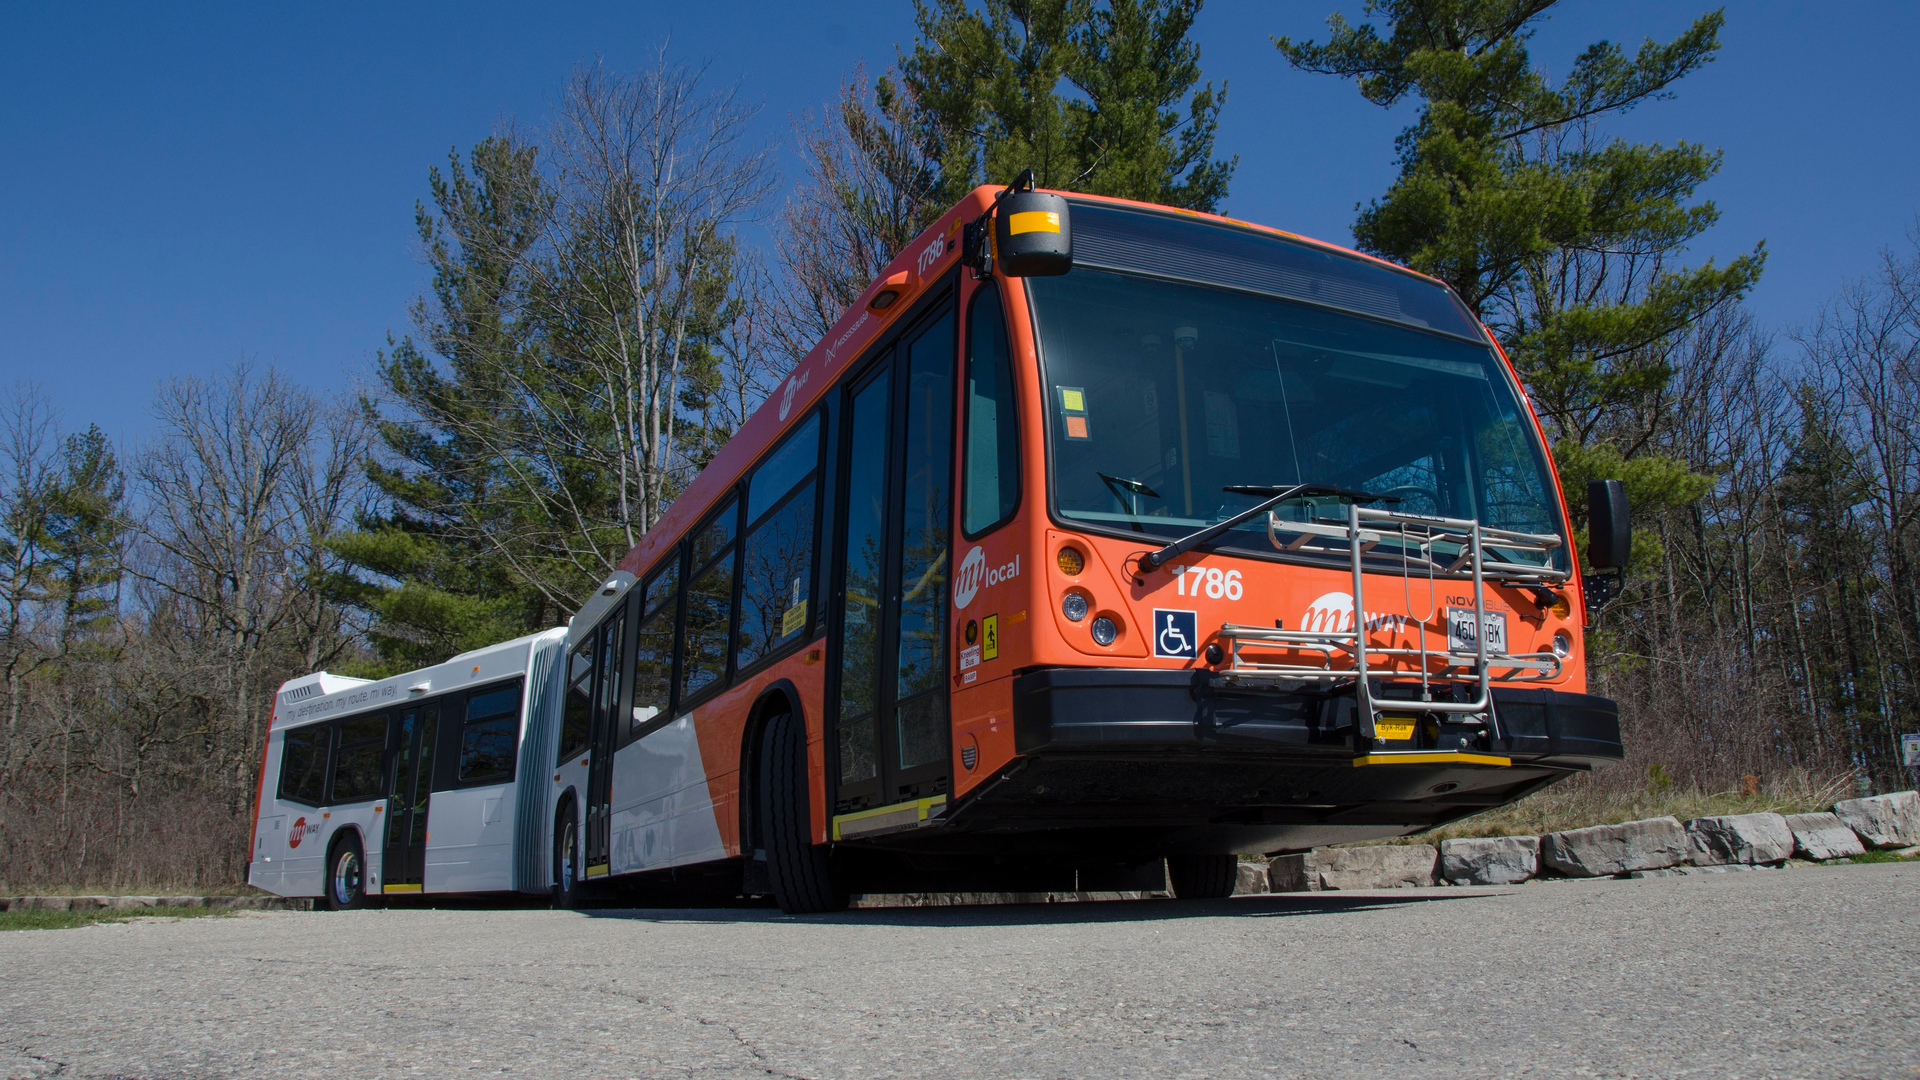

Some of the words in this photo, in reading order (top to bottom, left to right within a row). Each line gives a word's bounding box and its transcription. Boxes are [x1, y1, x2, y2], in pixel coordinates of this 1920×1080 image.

[917, 232, 945, 276] 1786
[985, 553, 1020, 588] local
[1171, 564, 1244, 601] 1786
[1455, 620, 1475, 641] 450
[961, 647, 979, 660] Kneeling
[965, 658, 975, 667] Bus
[286, 710, 297, 721] my
[297, 699, 334, 717] destination.
[335, 698, 348, 709] my
[347, 691, 369, 705] route.
[370, 686, 380, 700] mi
[381, 684, 398, 698] way.
